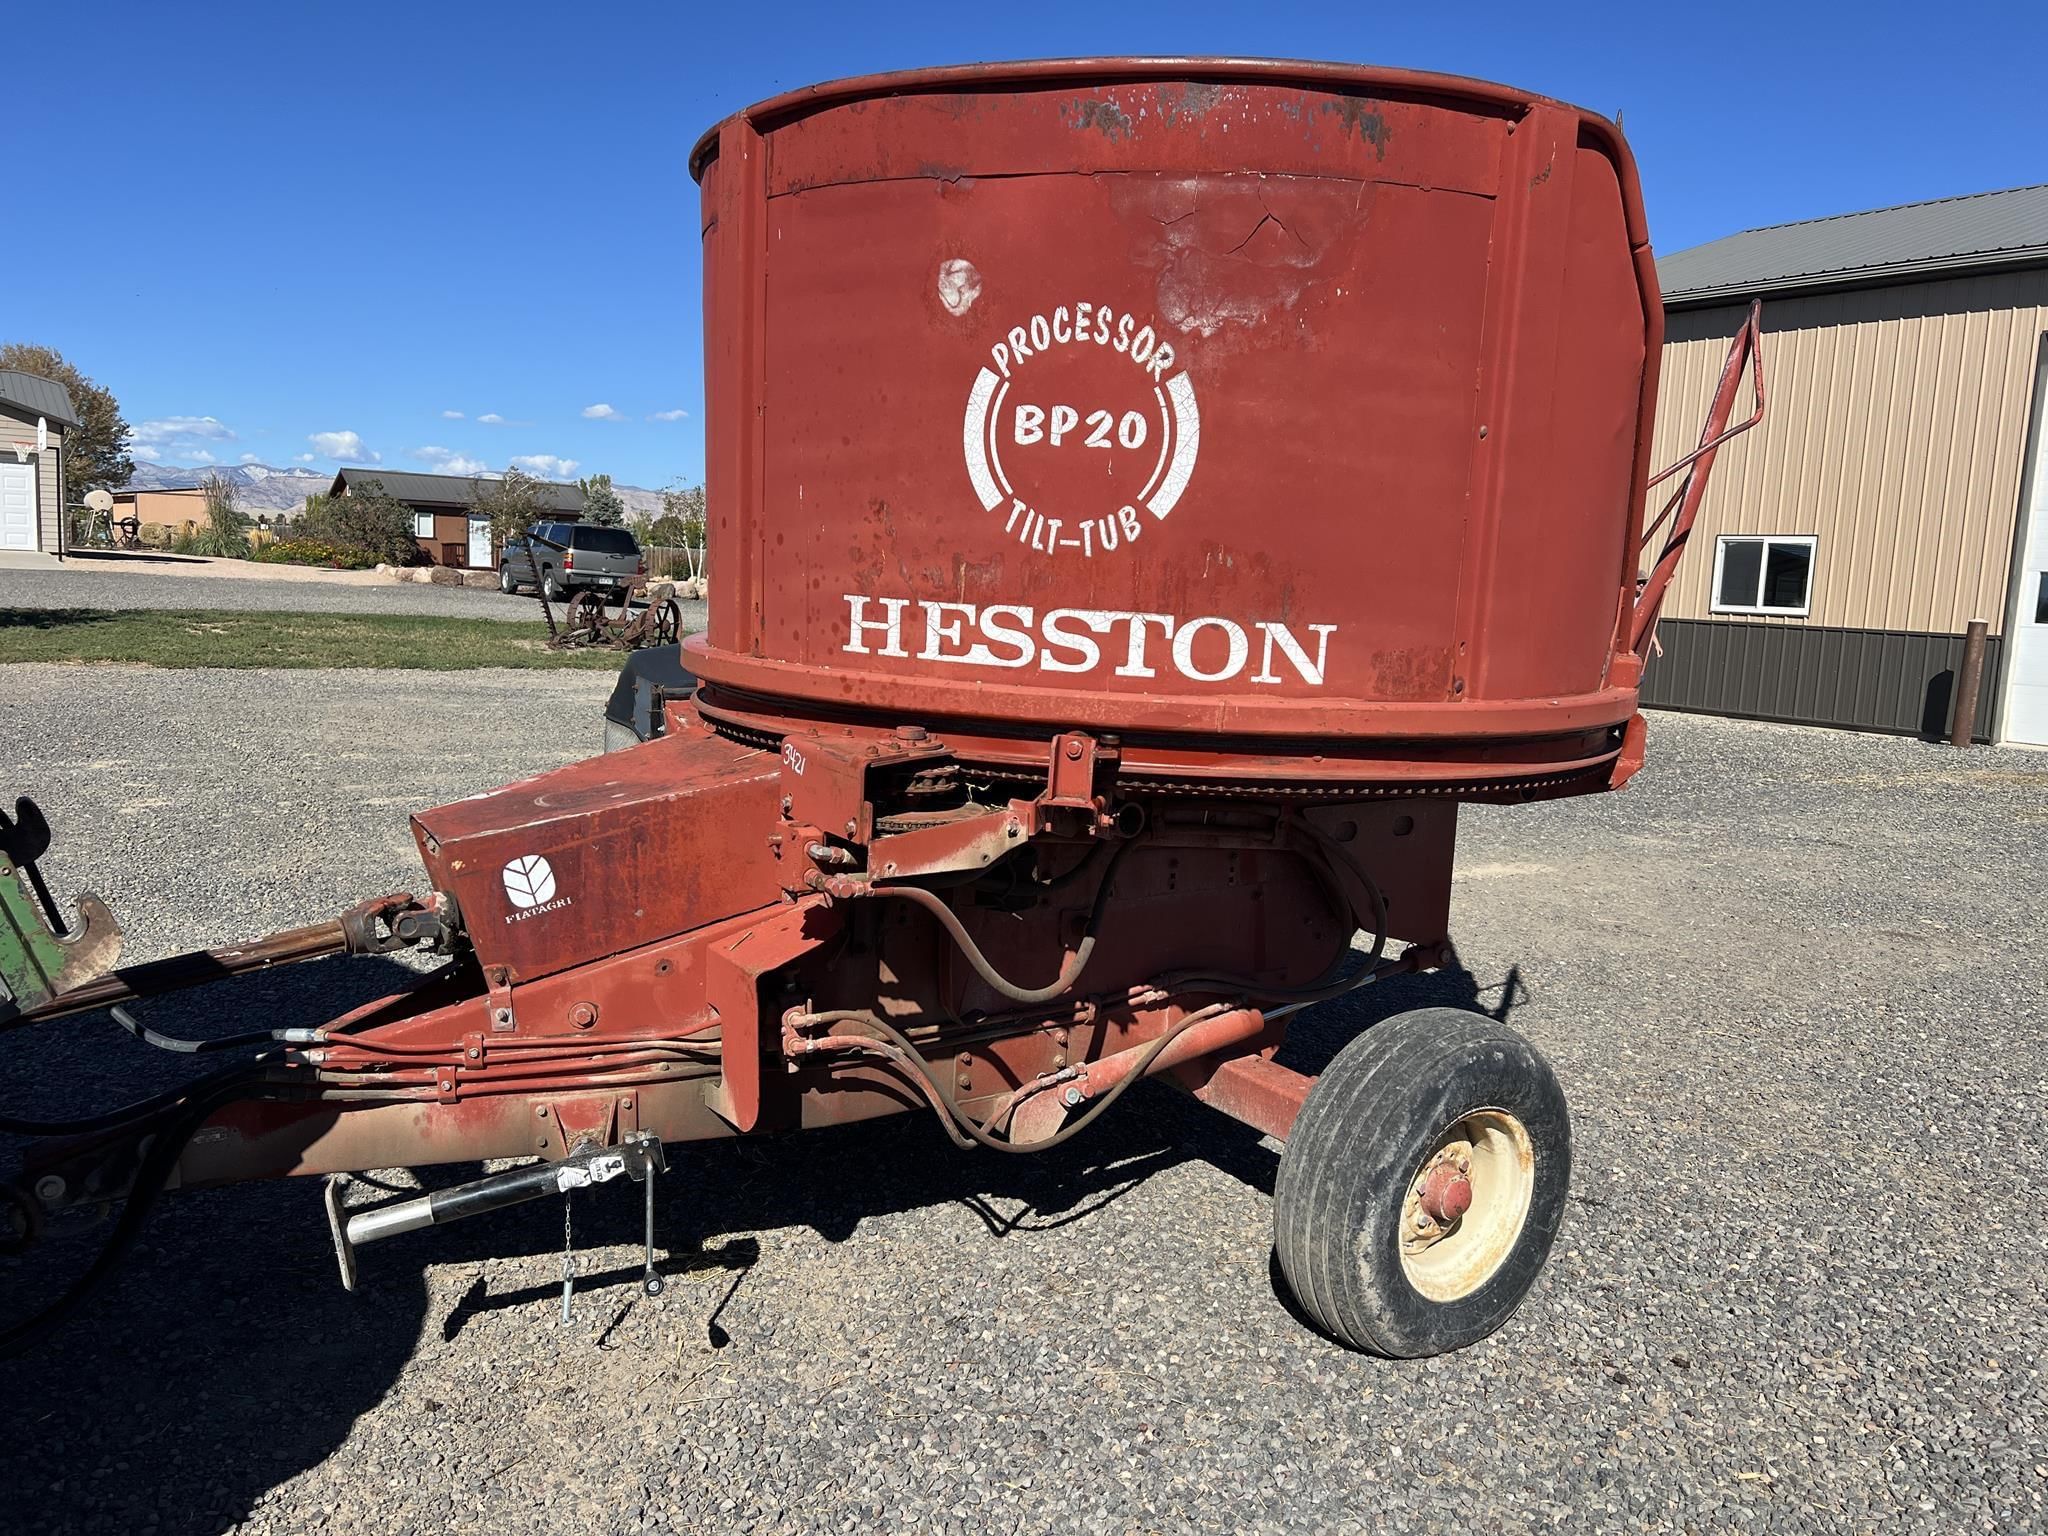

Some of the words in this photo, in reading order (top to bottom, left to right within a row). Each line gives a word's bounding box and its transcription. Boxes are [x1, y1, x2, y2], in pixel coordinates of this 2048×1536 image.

[991, 302, 1176, 382] PROCESSOR
[1005, 498, 1142, 557] TILT-TUB
[842, 594, 1338, 685] HESSTON
[783, 743, 806, 776] 3421
[505, 897, 572, 924] FIATAGRI
